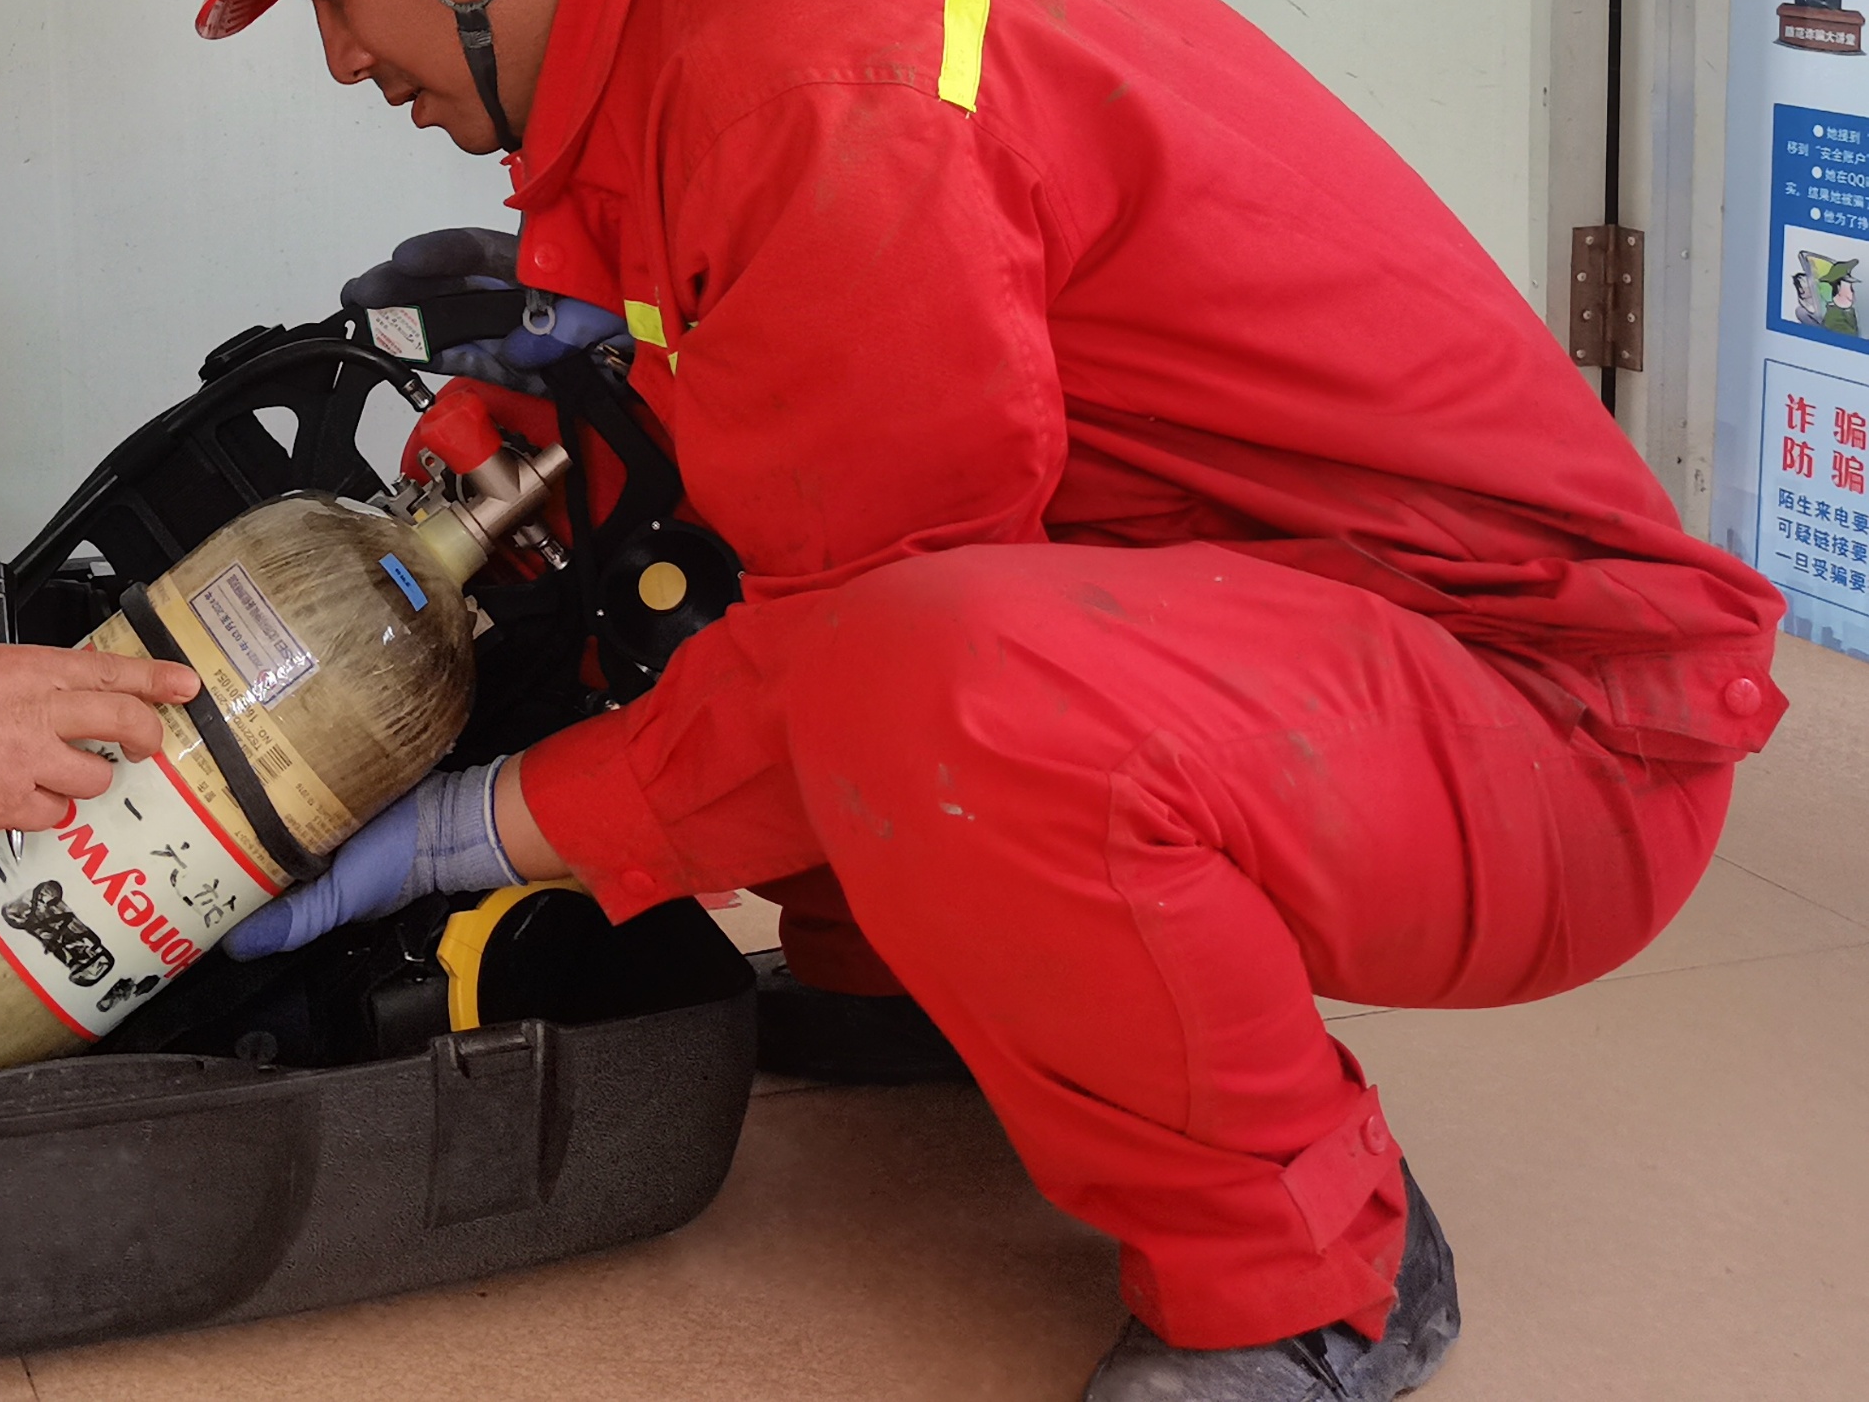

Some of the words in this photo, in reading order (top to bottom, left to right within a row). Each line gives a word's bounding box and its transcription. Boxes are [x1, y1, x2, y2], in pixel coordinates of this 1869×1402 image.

[1825, 167, 1869, 189] 她在QQ
[1785, 393, 1867, 451] 诈骗
[1781, 435, 1865, 495] 防骗
[254, 724, 273, 745] NO.
[52, 798, 204, 980] Honeyw
